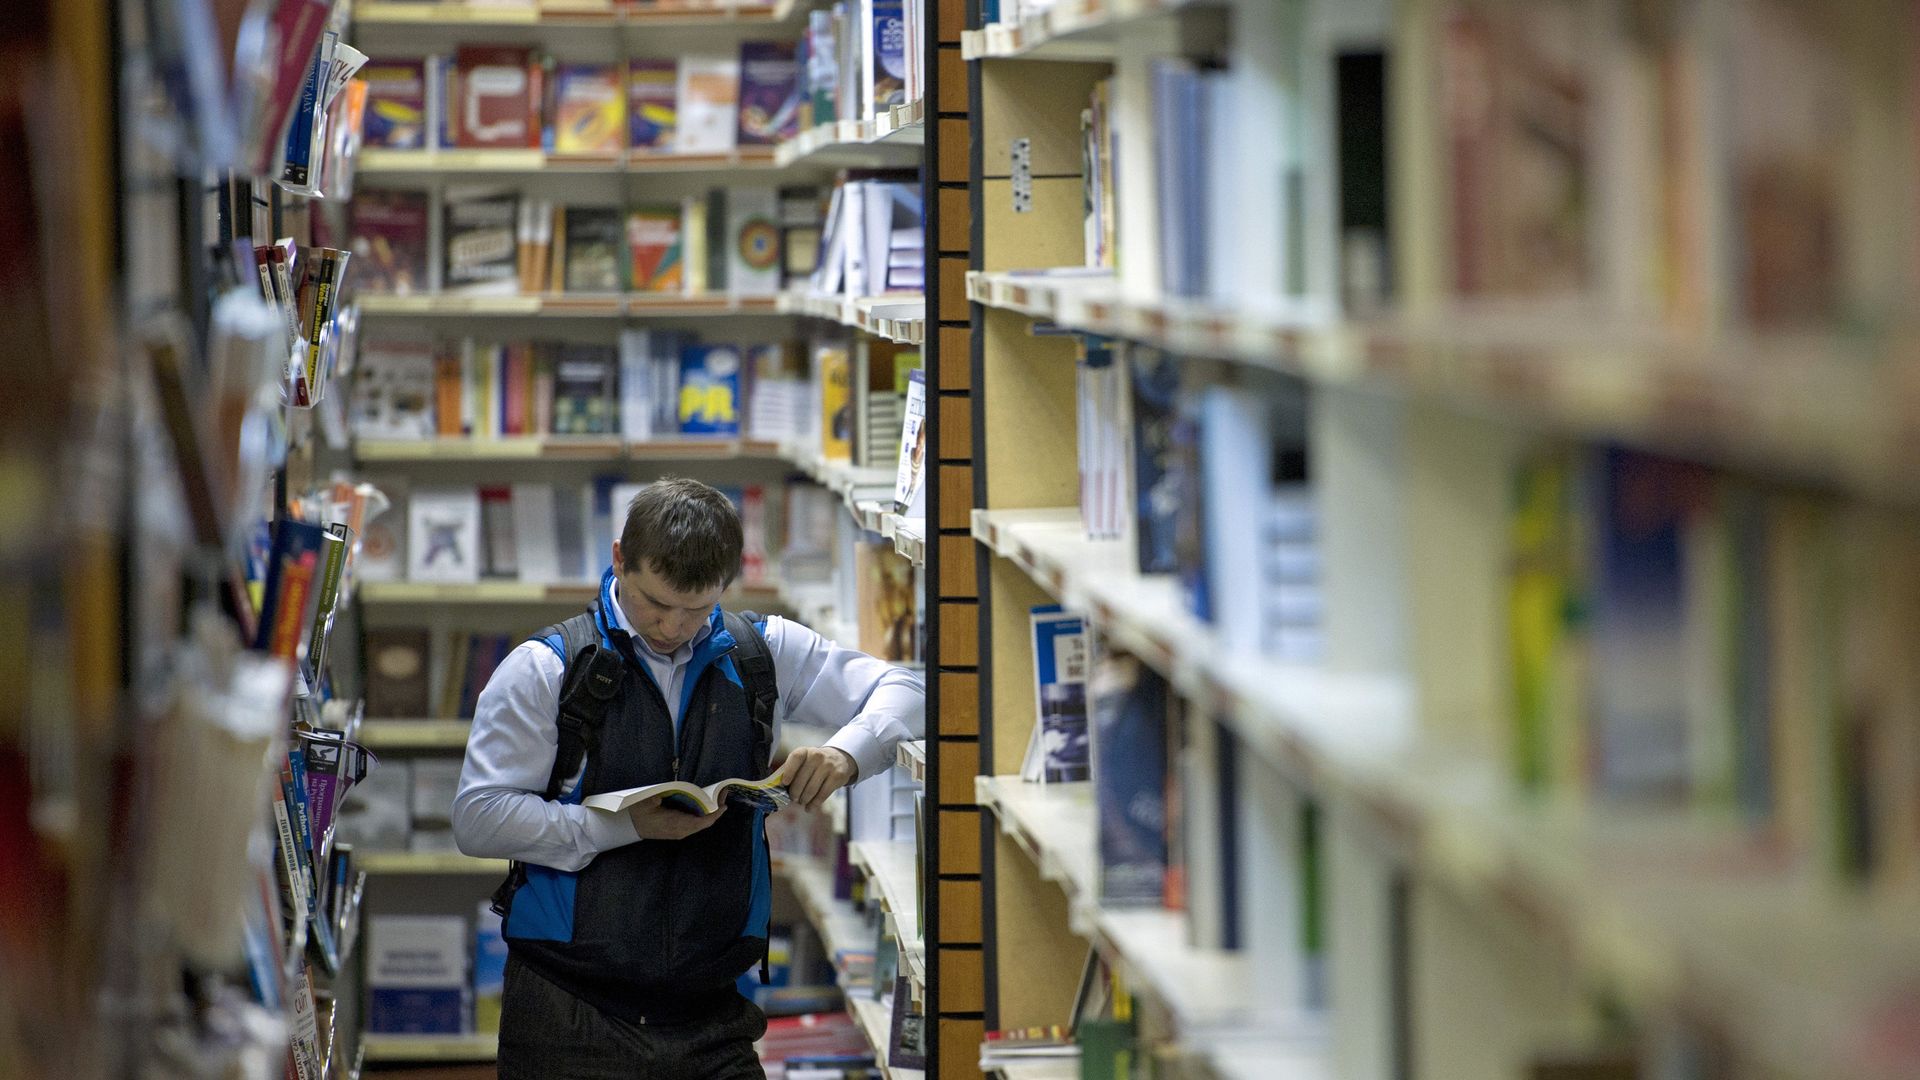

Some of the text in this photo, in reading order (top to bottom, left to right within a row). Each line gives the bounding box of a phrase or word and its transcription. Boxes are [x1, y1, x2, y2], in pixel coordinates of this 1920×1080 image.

[303, 91, 312, 113] AJAX
[297, 802, 308, 836] Python
[284, 834, 297, 872] FRAMEWORK
